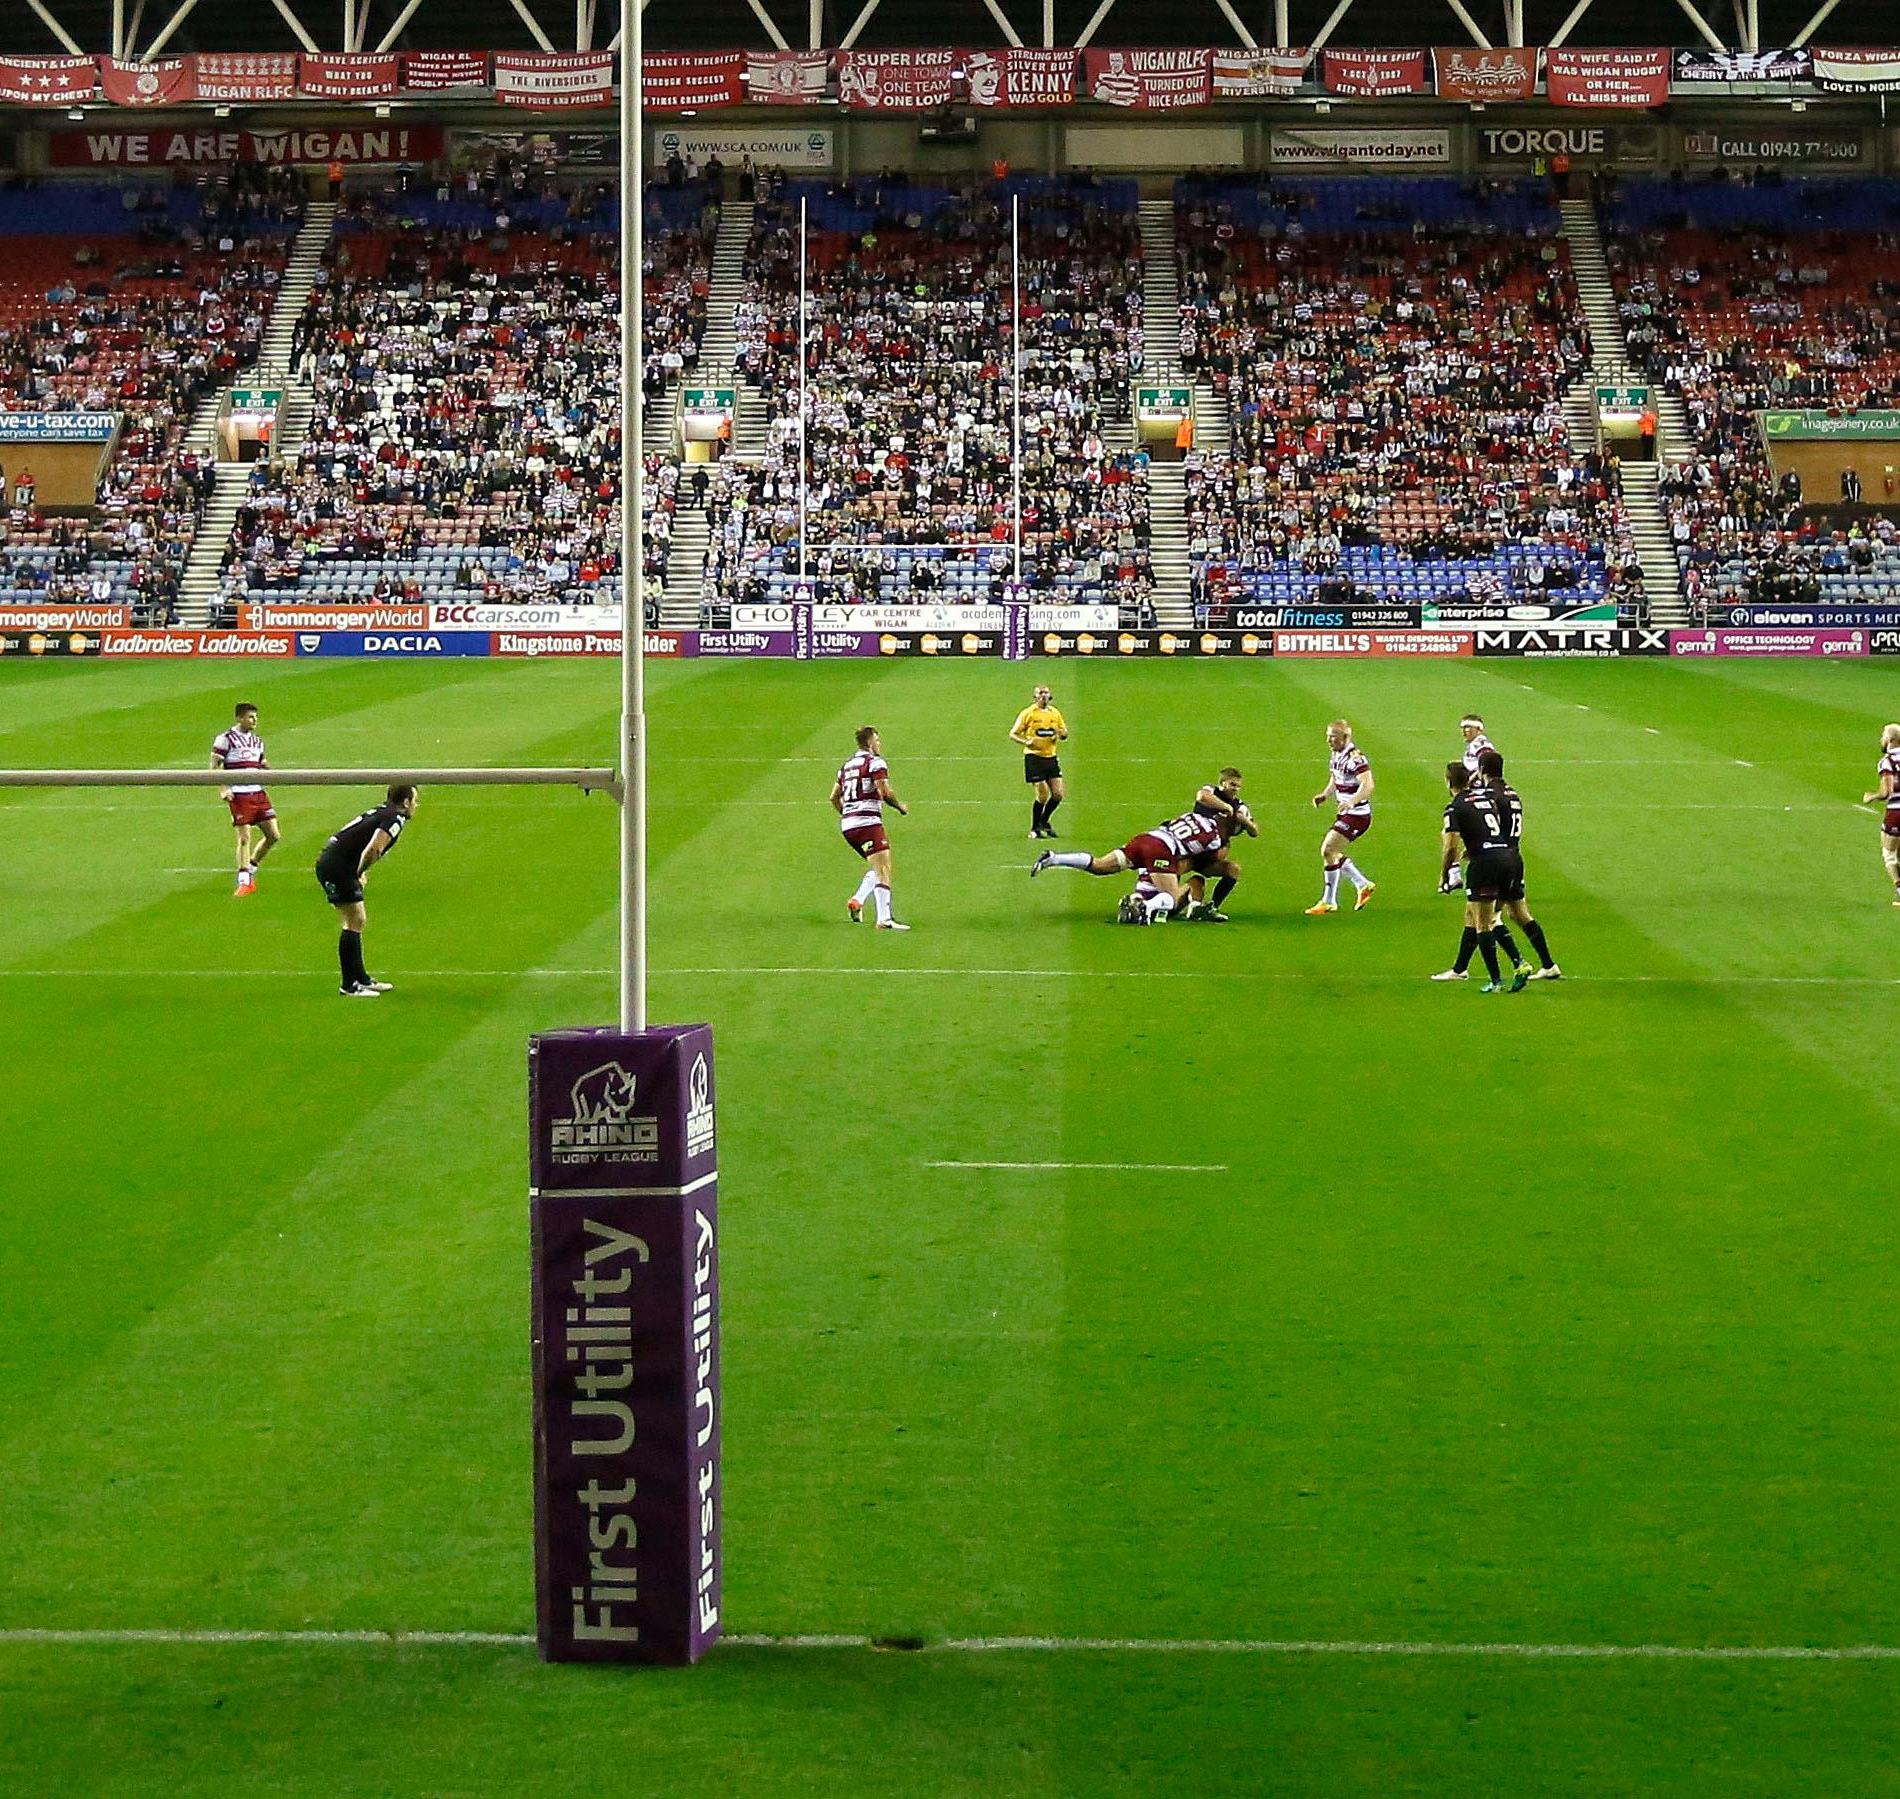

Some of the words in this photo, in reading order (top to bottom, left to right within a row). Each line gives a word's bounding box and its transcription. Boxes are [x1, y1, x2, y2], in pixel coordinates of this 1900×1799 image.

[858, 52, 910, 66] SUPER
[915, 51, 953, 64] KRIS
[1007, 50, 1051, 61] STERLING
[1053, 50, 1075, 60] WAS
[1131, 51, 1177, 70] WIGAN
[1179, 49, 1210, 69] RLFC
[1218, 49, 1260, 59] WIGAN
[1558, 52, 1575, 62] MY
[1580, 53, 1610, 62] WIFE
[1614, 53, 1645, 62] SAID
[1647, 52, 1658, 61] IT
[1820, 50, 1861, 60] FORZA
[59, 56, 95, 68] LOYAL
[112, 60, 159, 73] WIGAN
[1007, 61, 1046, 70] SILVER
[1051, 61, 1073, 71] BUT
[325, 70, 352, 80] WHAT
[355, 70, 373, 79] YOU
[1552, 65, 1579, 76] WAS
[1581, 66, 1621, 77] WIGAN
[1625, 65, 1663, 76] RUGBY
[1681, 69, 1723, 80] CHERRY
[511, 75, 528, 86] THE
[534, 74, 598, 87] RIVERSIDERS
[883, 81, 913, 92] ONE
[915, 80, 951, 92] TEAM
[1007, 72, 1073, 92] KENNY
[1145, 77, 1184, 90] TURNED
[1186, 76, 1206, 89] OUT
[1586, 80, 1604, 89] OR
[1823, 81, 1853, 91] LOVE
[0, 88, 29, 101] UPON
[32, 90, 50, 102] MY
[53, 88, 92, 101] CHEST
[198, 85, 255, 98] WIGAN
[257, 85, 294, 98] RLFC
[1008, 93, 1035, 103] WAS
[1036, 93, 1072, 103] GOLD
[1590, 93, 1619, 102] MISS
[884, 95, 913, 106] ONE
[916, 94, 950, 106] LOVE
[1148, 94, 1171, 107] NICE
[86, 135, 149, 162] WE
[165, 132, 239, 161] ARE
[253, 130, 390, 161] WIGAN
[686, 142, 802, 154] WWW.SCA.COM/UK
[1484, 129, 1604, 155] TORQUE
[1273, 143, 1444, 160] www.wigantoday.net
[1722, 142, 1757, 156] CALL
[1760, 142, 1801, 155] 01942
[246, 399, 265, 408] EXIT
[699, 399, 719, 408] EXIT
[1154, 398, 1173, 407] EXIT
[1613, 397, 1632, 406] EXIT
[1802, 417, 1900, 432] imagejoinery.co.uk
[41, 430, 61, 438] can
[64, 430, 86, 438] save
[265, 607, 423, 630] IronmongeryWorld
[435, 606, 560, 624] BCCcars.com
[860, 609, 882, 617] CAR
[885, 609, 922, 617] CENTRE
[1237, 608, 1343, 627] totalfitness
[1351, 611, 1375, 620] 01942
[1754, 611, 1814, 624] eleven
[1818, 613, 1869, 624] SPORTS
[103, 634, 194, 654] Ladbrokes
[198, 634, 289, 654] Ladbrokes
[363, 637, 441, 651] DACIA
[499, 634, 582, 655] Kingstone
[699, 633, 727, 647] First
[729, 633, 770, 649] Utility
[821, 633, 861, 649] Utility
[1278, 635, 1370, 652] BITHELL'S
[1375, 635, 1405, 643] WASTE
[1407, 635, 1450, 643] DISPOSAL
[1452, 634, 1469, 643] LTD
[1478, 630, 1666, 649] MATRIX
[1723, 635, 1752, 644] OFFICE
[1754, 635, 1816, 645] TECHNOLOGY
[1676, 638, 1716, 654] gemini
[1822, 638, 1862, 654] gemini
[1485, 813, 1500, 837] 9
[1510, 813, 1522, 838] 13
[687, 1113, 714, 1139] RHINO
[552, 1124, 659, 1144] RHINO
[552, 1152, 600, 1164] RUGBY
[604, 1151, 659, 1163] LEAGUE
[692, 1208, 715, 1450] Utility
[566, 1218, 649, 1457] Utility
[698, 1459, 716, 1636] First
[571, 1478, 639, 1643] First
